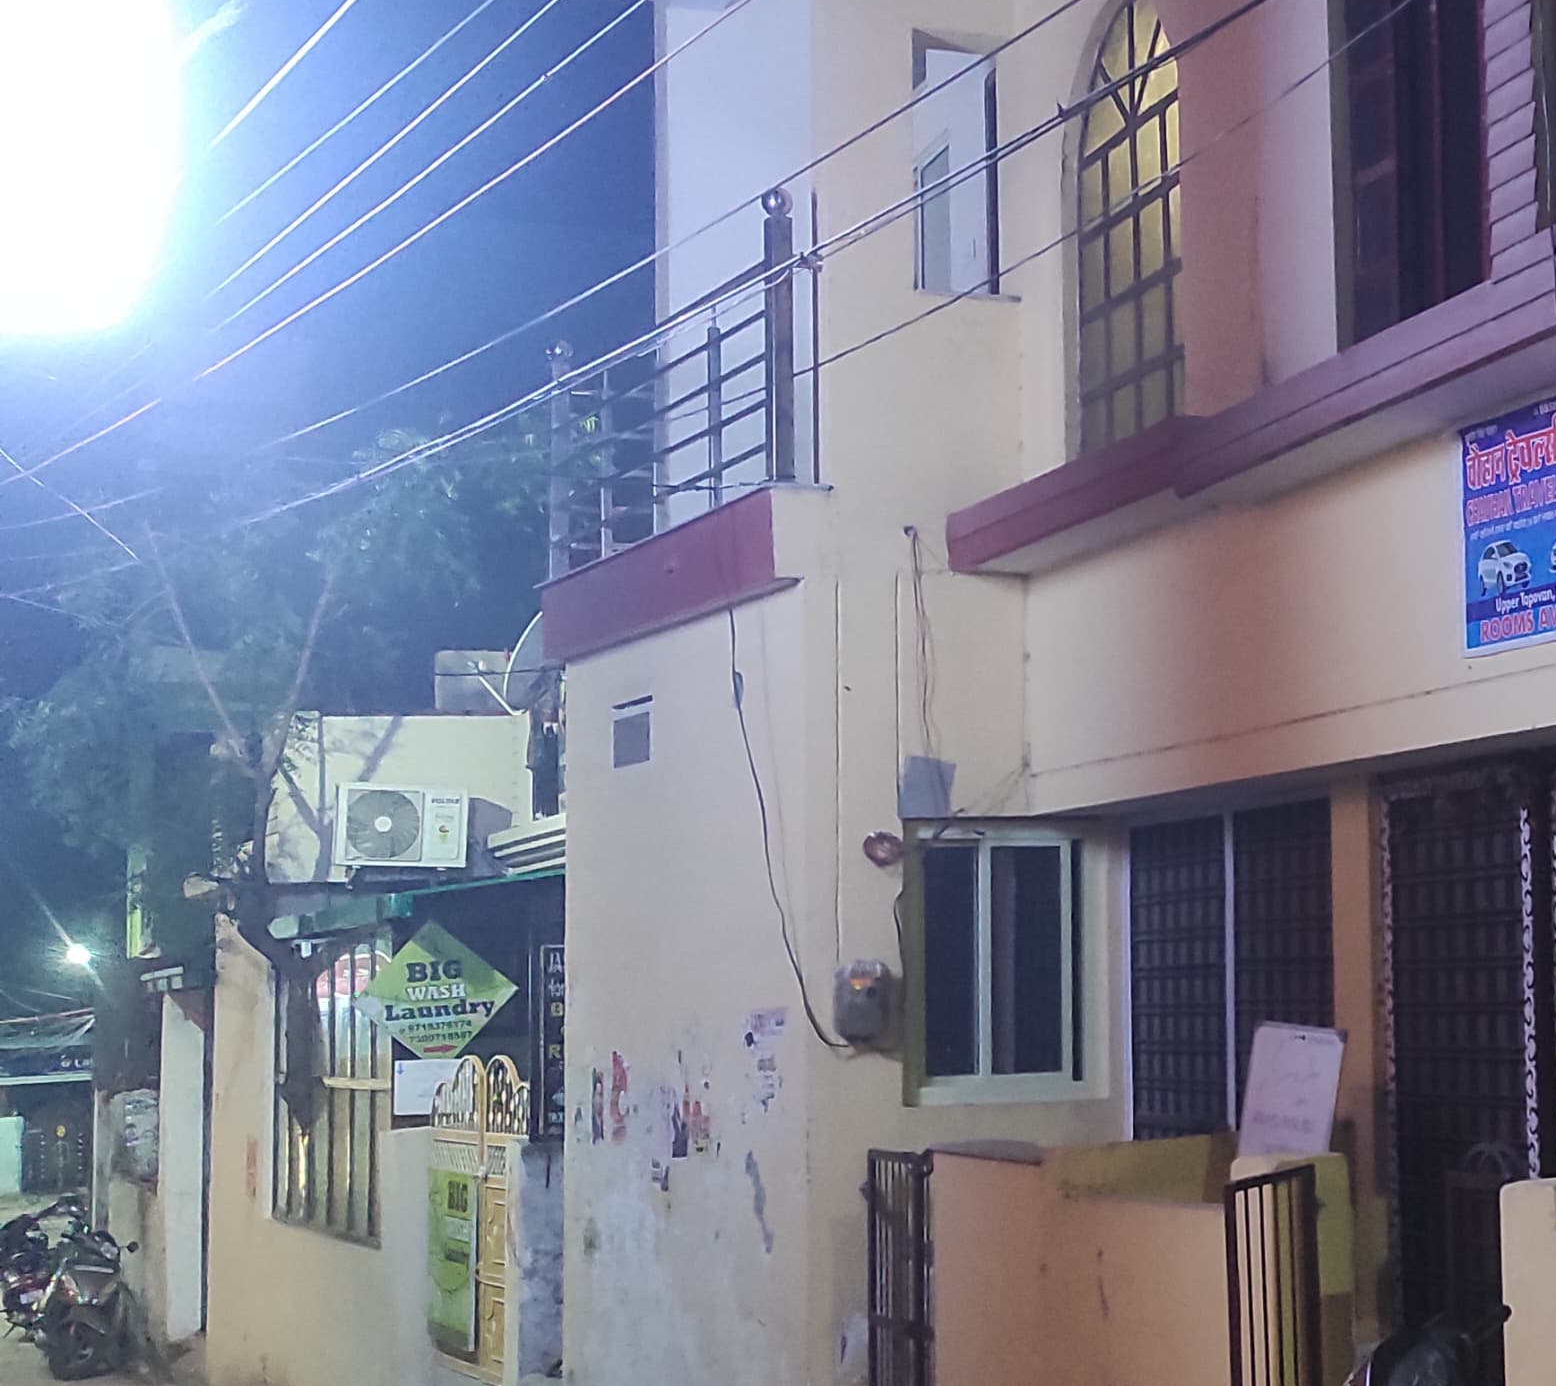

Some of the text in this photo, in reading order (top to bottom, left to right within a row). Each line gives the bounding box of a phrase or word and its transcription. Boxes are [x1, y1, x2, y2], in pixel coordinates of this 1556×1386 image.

[1495, 594, 1519, 614] Upper
[1481, 609, 1534, 643] ROOMS
[406, 960, 463, 983] BIG
[407, 984, 466, 1001] WASH
[384, 1000, 496, 1023] Laundry
